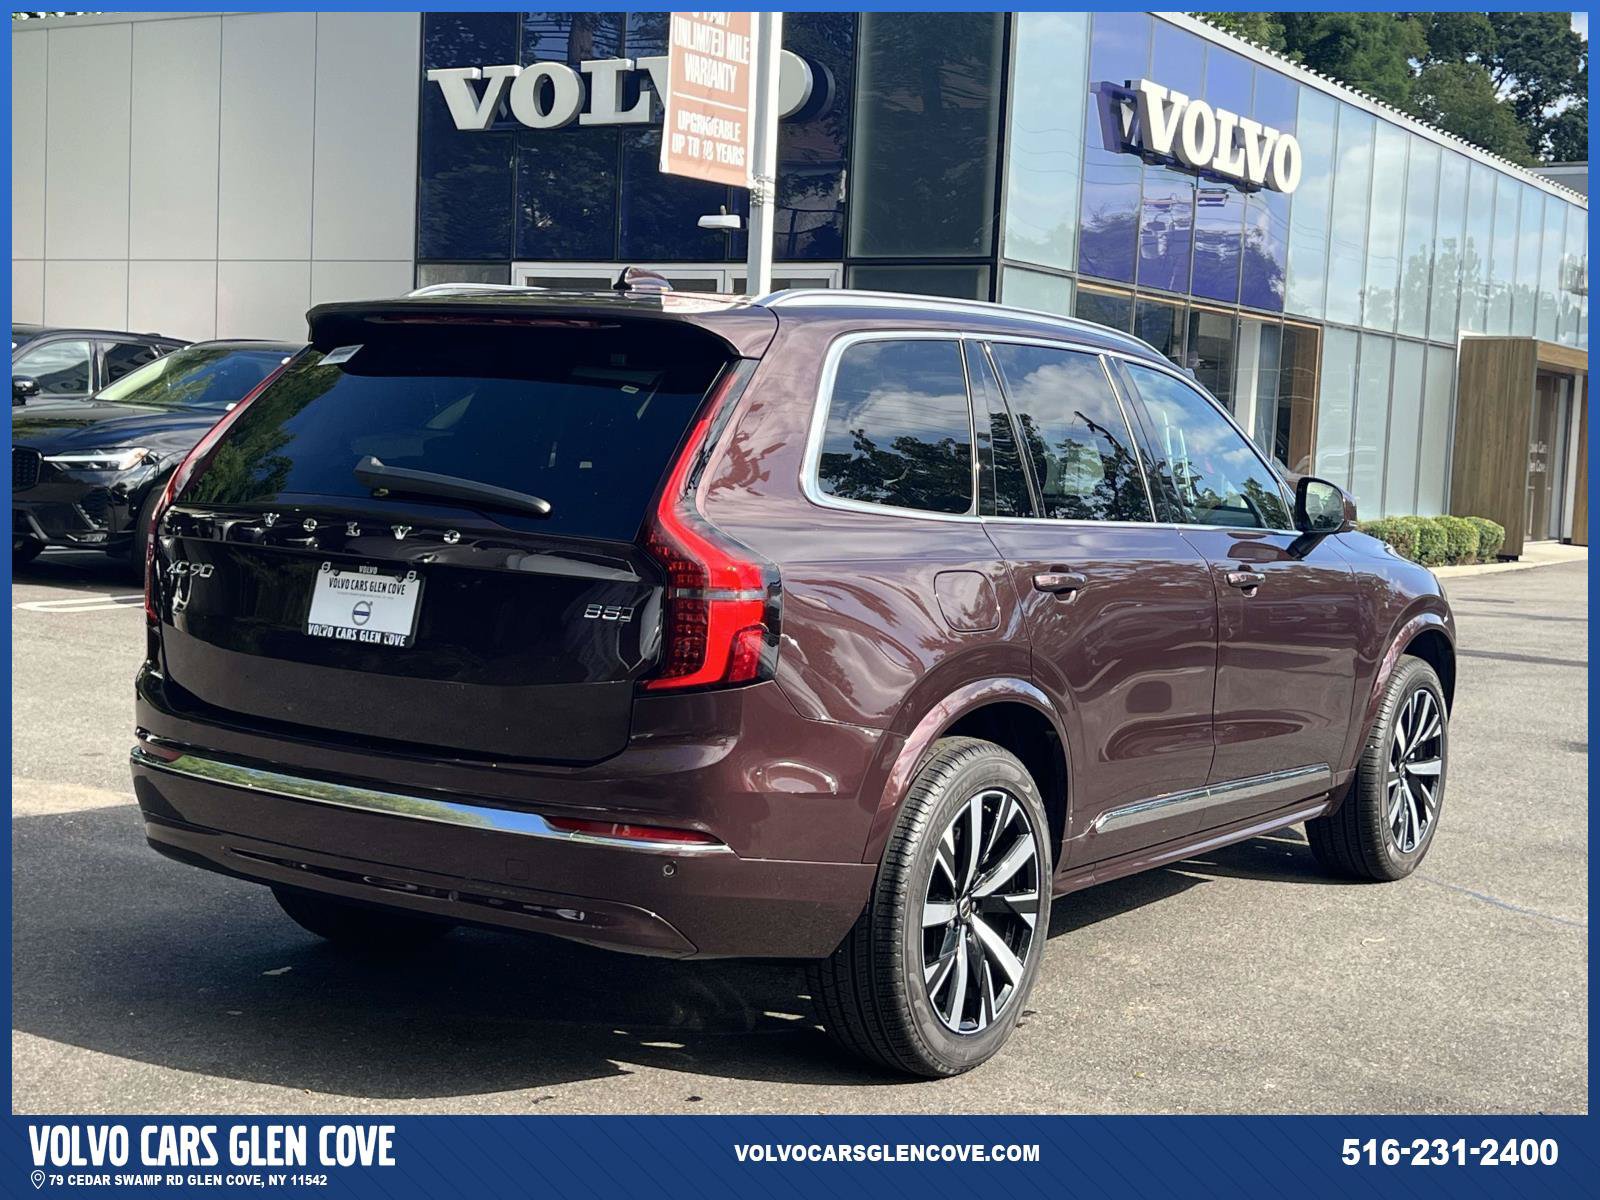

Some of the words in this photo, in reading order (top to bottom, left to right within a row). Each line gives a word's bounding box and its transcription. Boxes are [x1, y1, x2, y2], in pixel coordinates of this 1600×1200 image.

[726, 31, 750, 65] MILE
[684, 52, 737, 94] WARRANTY
[671, 132, 686, 154] UP
[686, 135, 700, 158] TO
[716, 142, 745, 168] YEARS
[1136, 79, 1302, 194] VOLVO
[262, 512, 461, 545] VOLVO
[166, 559, 215, 578] XC90
[359, 565, 378, 574] VOLVO
[329, 577, 350, 590] VOLVO
[350, 579, 368, 592] CARS
[369, 580, 386, 594] GLEN
[387, 582, 406, 595] COVE
[308, 623, 333, 638] VOLVO
[335, 627, 357, 640] CARS
[359, 630, 381, 644] GLEN
[383, 633, 406, 647] COVE
